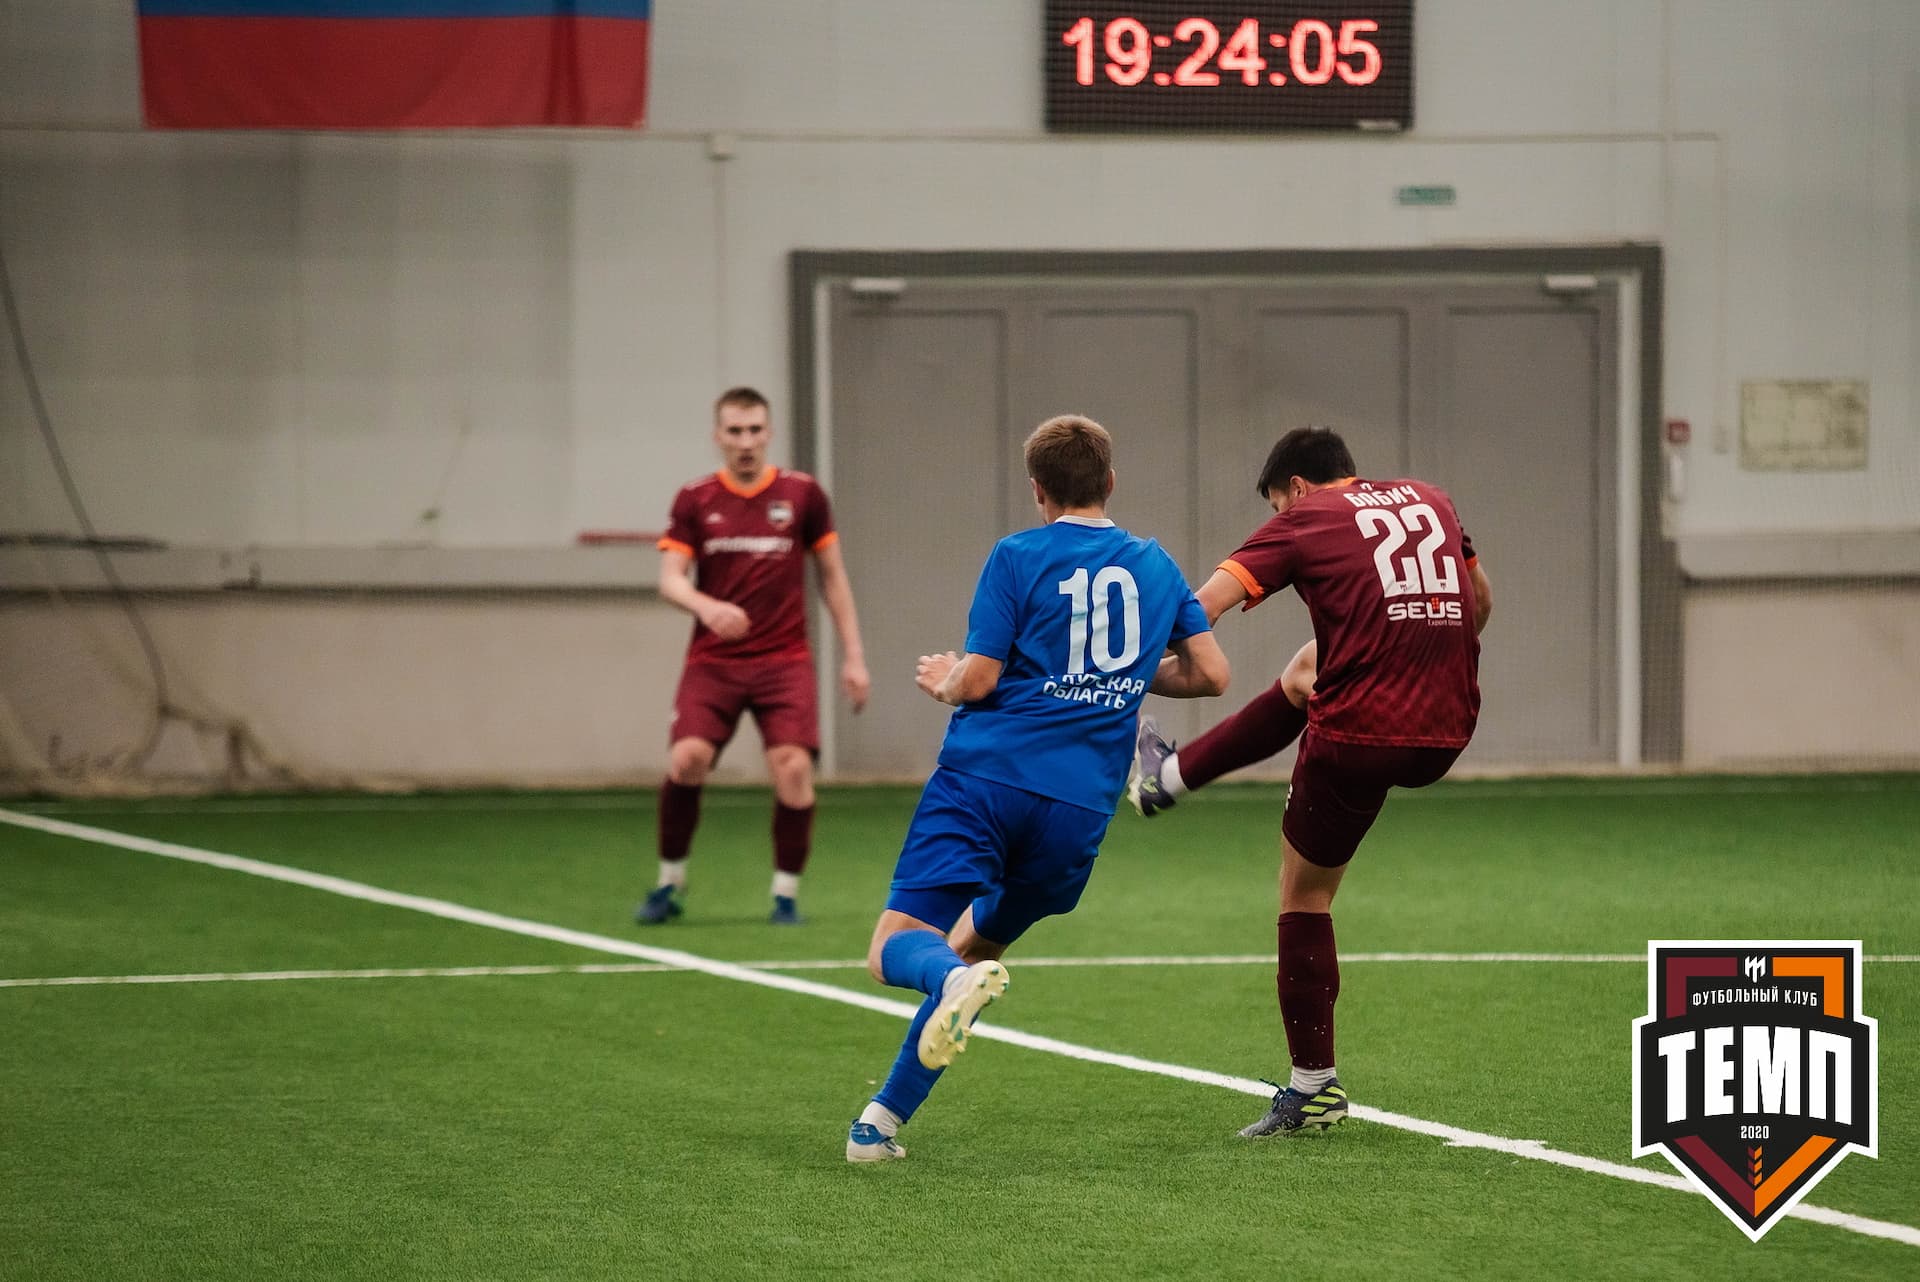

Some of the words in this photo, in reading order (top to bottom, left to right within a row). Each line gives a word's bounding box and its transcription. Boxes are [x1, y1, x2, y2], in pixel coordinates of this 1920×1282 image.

[1062, 16, 1383, 87] 19:24:05
[1343, 484, 1422, 508] БАБИЧ
[1354, 503, 1461, 599] 22
[1058, 565, 1141, 675] 10
[1387, 599, 1463, 622] SEUS
[1043, 681, 1127, 710] ОБЛАСТЬ
